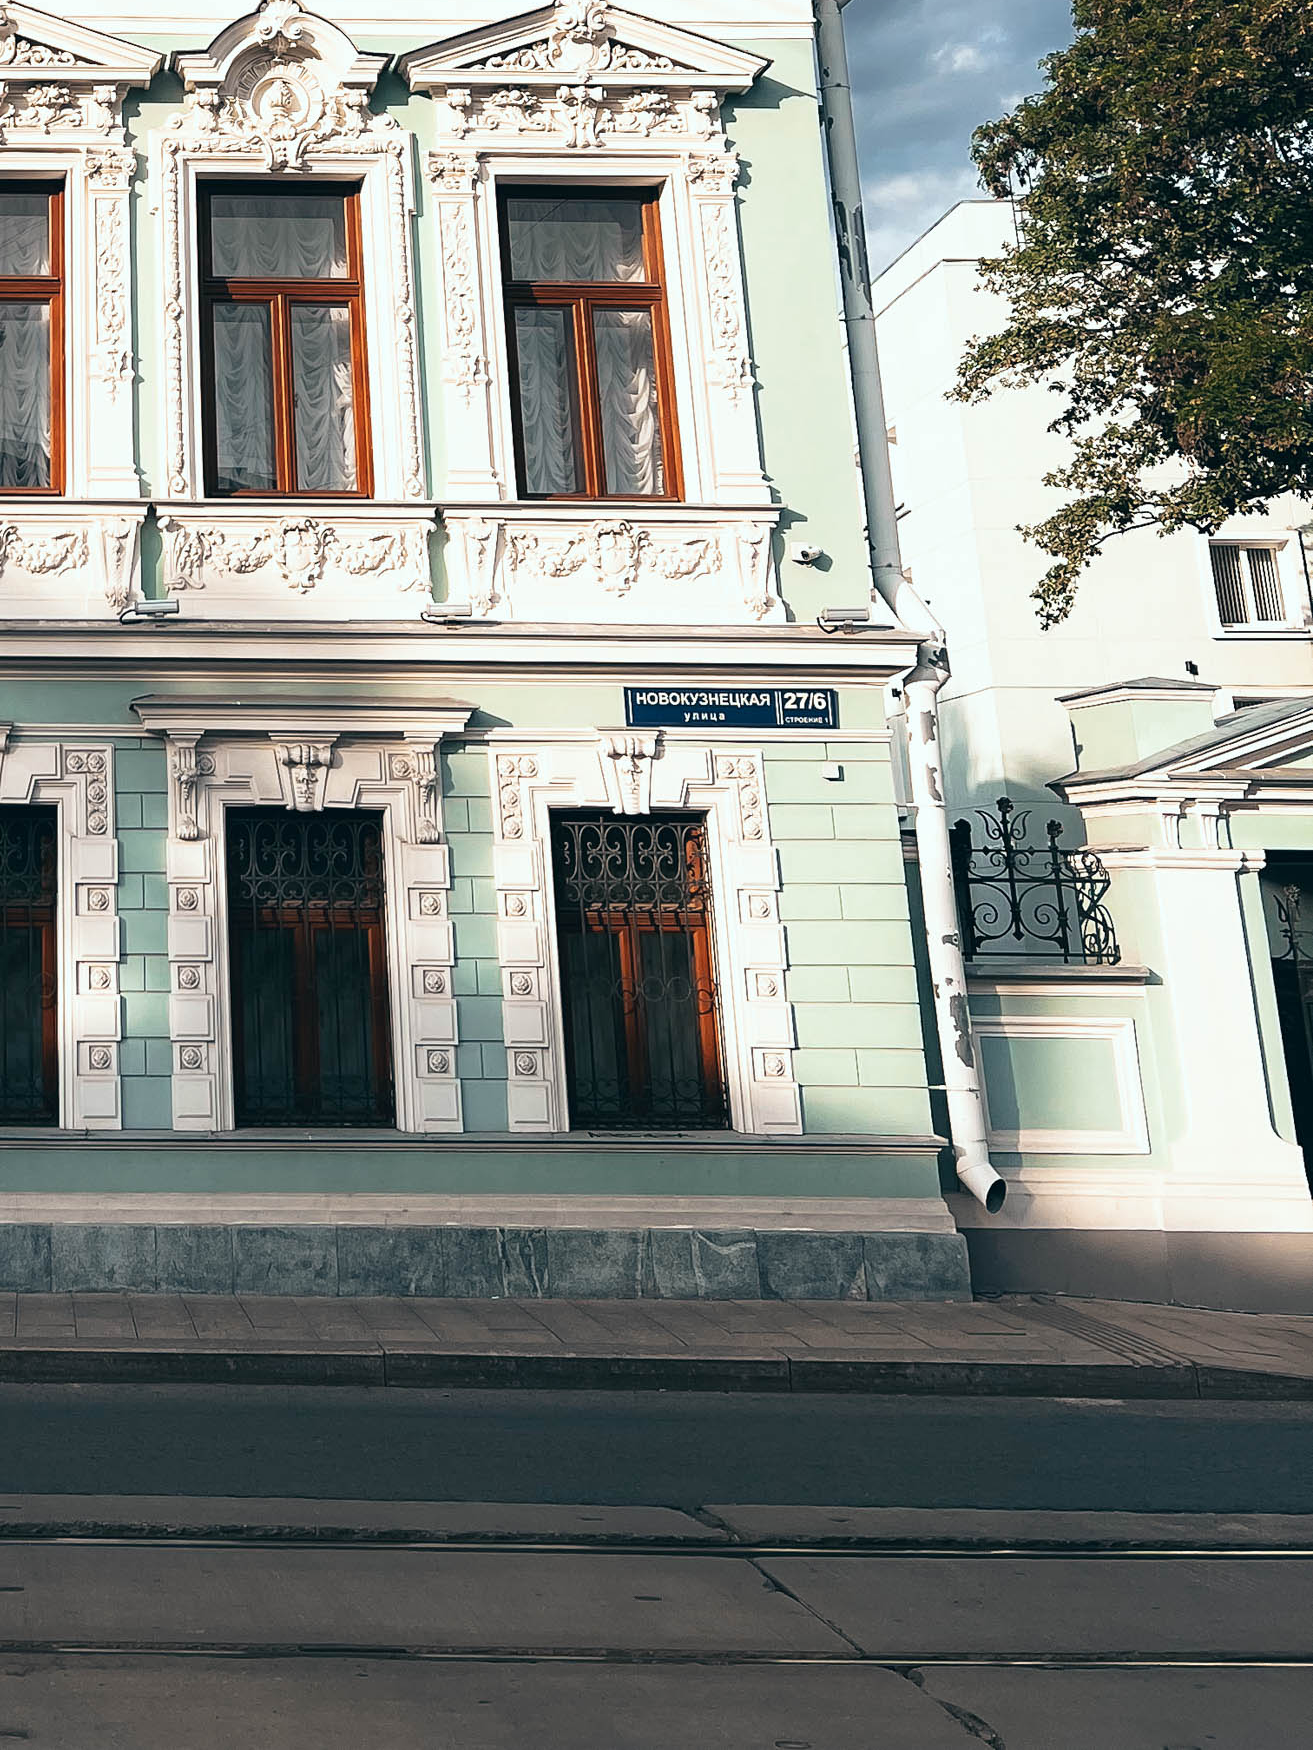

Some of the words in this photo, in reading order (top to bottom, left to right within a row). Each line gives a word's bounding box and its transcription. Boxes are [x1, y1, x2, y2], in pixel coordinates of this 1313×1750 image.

[636, 692, 771, 708] НОВОКУЗНЕЦКАЯ
[783, 692, 827, 710] 27/6
[683, 711, 726, 723] улица
[785, 716, 823, 724] СТРОЕНИЕ
